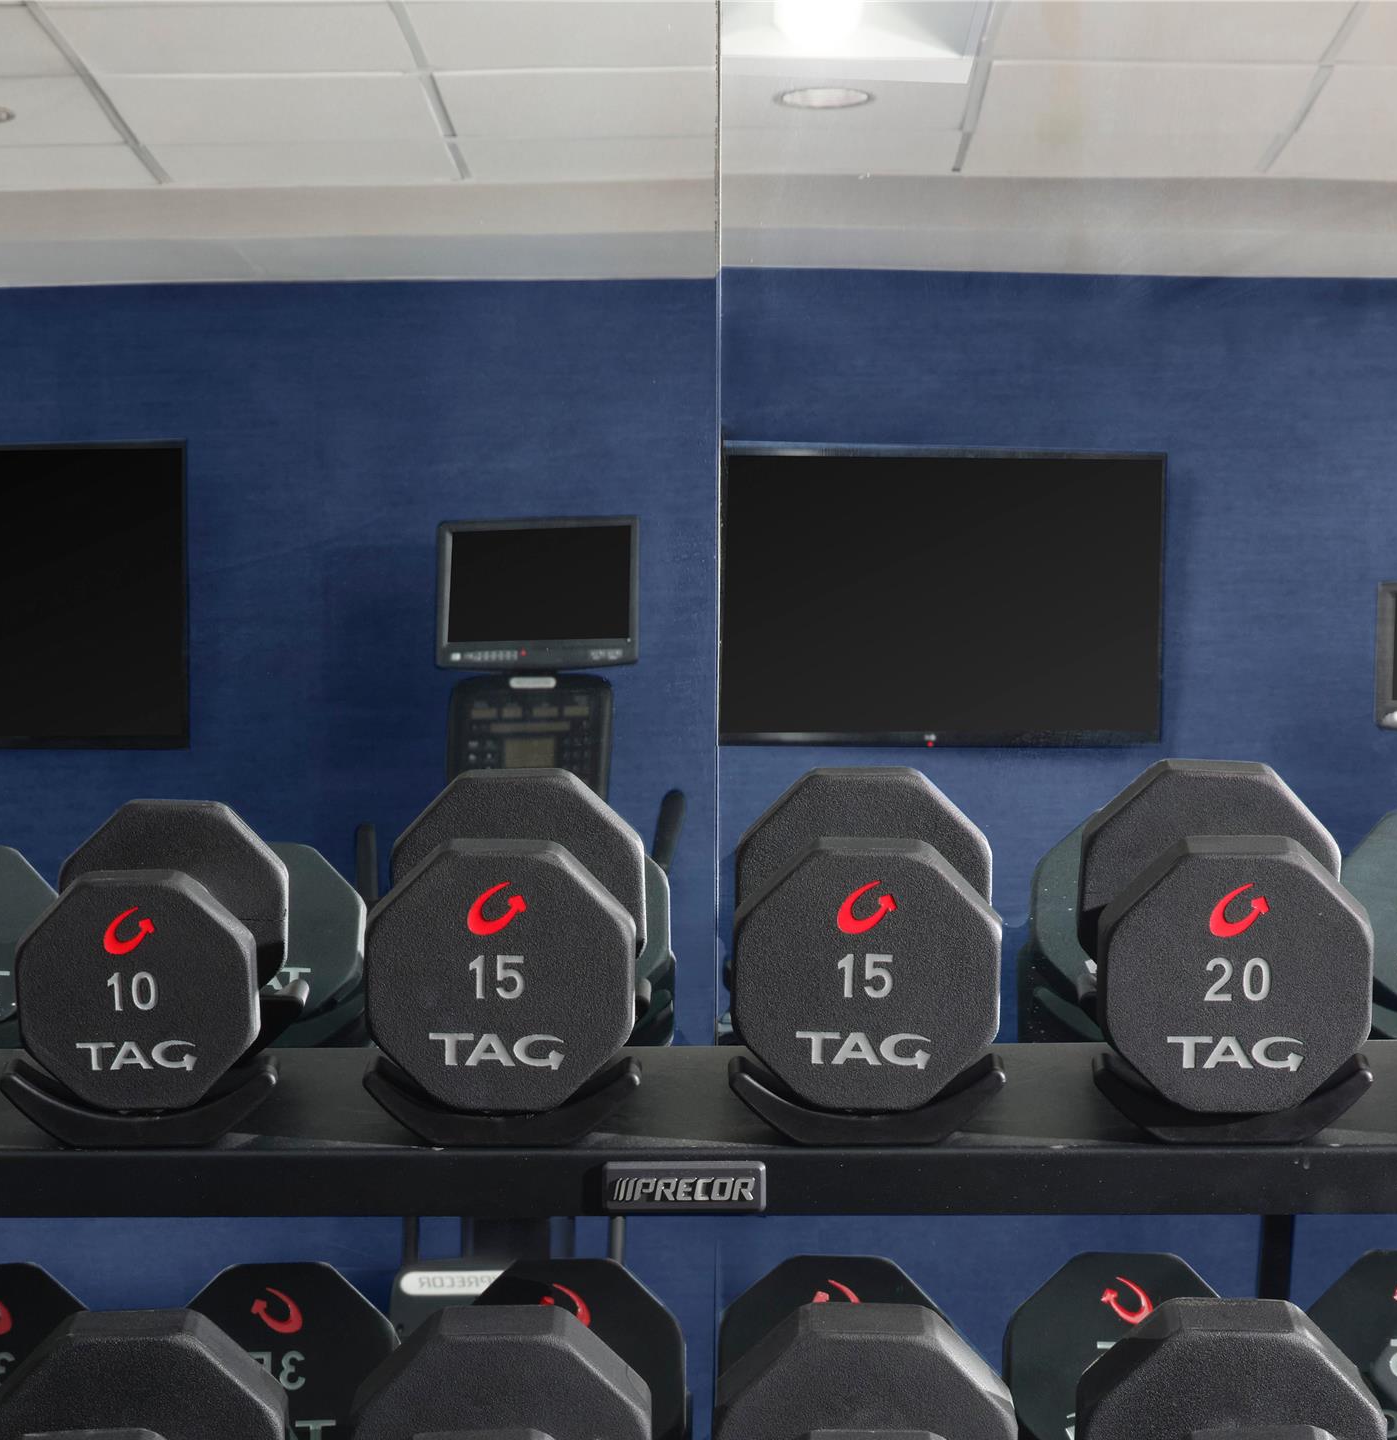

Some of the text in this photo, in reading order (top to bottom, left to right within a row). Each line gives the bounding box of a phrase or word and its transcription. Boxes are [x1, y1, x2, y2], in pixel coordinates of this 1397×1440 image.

[105, 970, 158, 1013] 10
[467, 953, 525, 1001] 15
[836, 952, 894, 1000] 15
[1202, 956, 1271, 1003] 20
[74, 1038, 197, 1073] TAG
[427, 1031, 565, 1072] TAG
[794, 1029, 931, 1071] TAG
[1165, 1034, 1303, 1073] TAG
[632, 1176, 757, 1202] PRECOR
